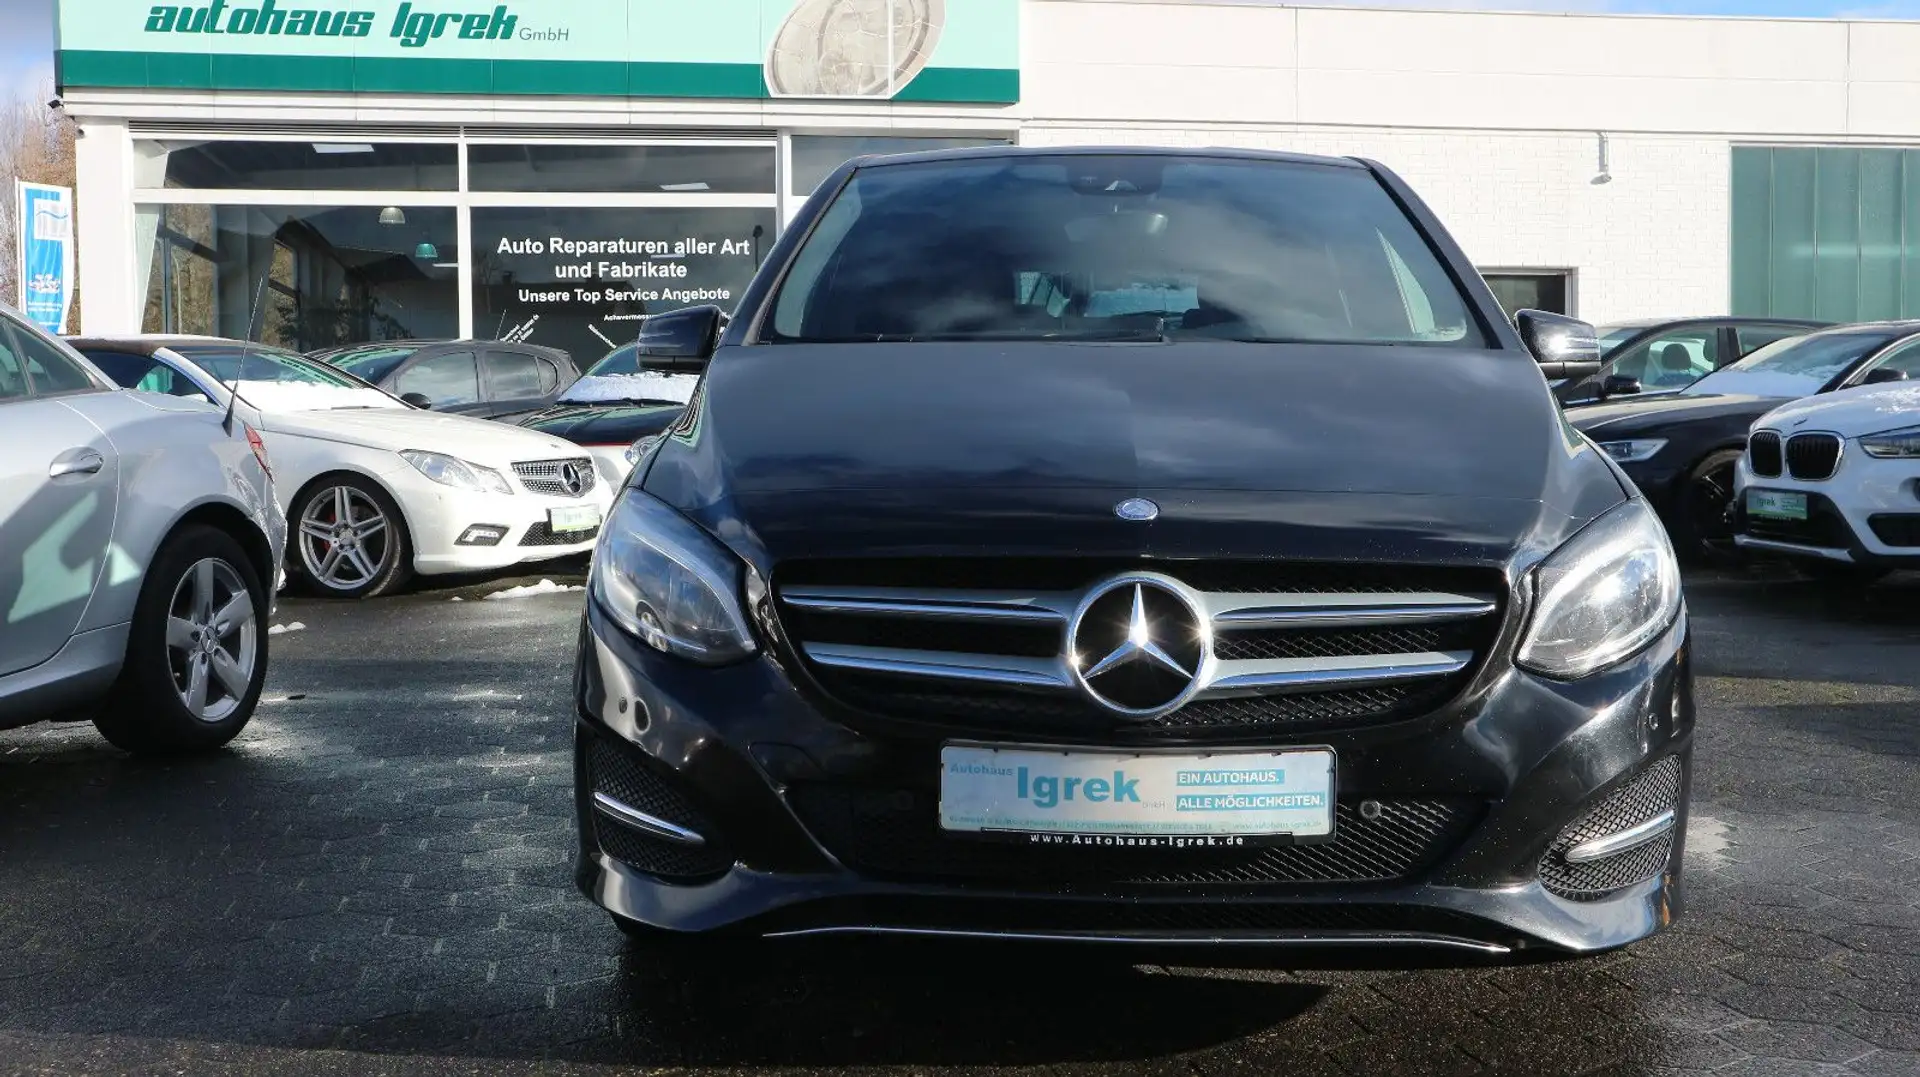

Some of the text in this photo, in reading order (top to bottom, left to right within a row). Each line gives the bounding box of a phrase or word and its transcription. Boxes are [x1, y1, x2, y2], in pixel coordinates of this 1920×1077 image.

[144, 0, 569, 48] autohaus Igrek GmbH
[497, 237, 750, 258] Auto Reparaturen aller Art
[555, 261, 688, 278] und Fabrikate
[518, 287, 731, 304] Unsere Top Service Angebote
[949, 763, 1014, 776] Autohaus
[1017, 766, 1141, 809] Igrek
[1178, 772, 1280, 784] EIN AUTOHAUS.
[1177, 793, 1324, 809] ALLE MÖGLICHKEITEN.
[1029, 833, 1244, 848] www.Autohaus-Igrek.de
